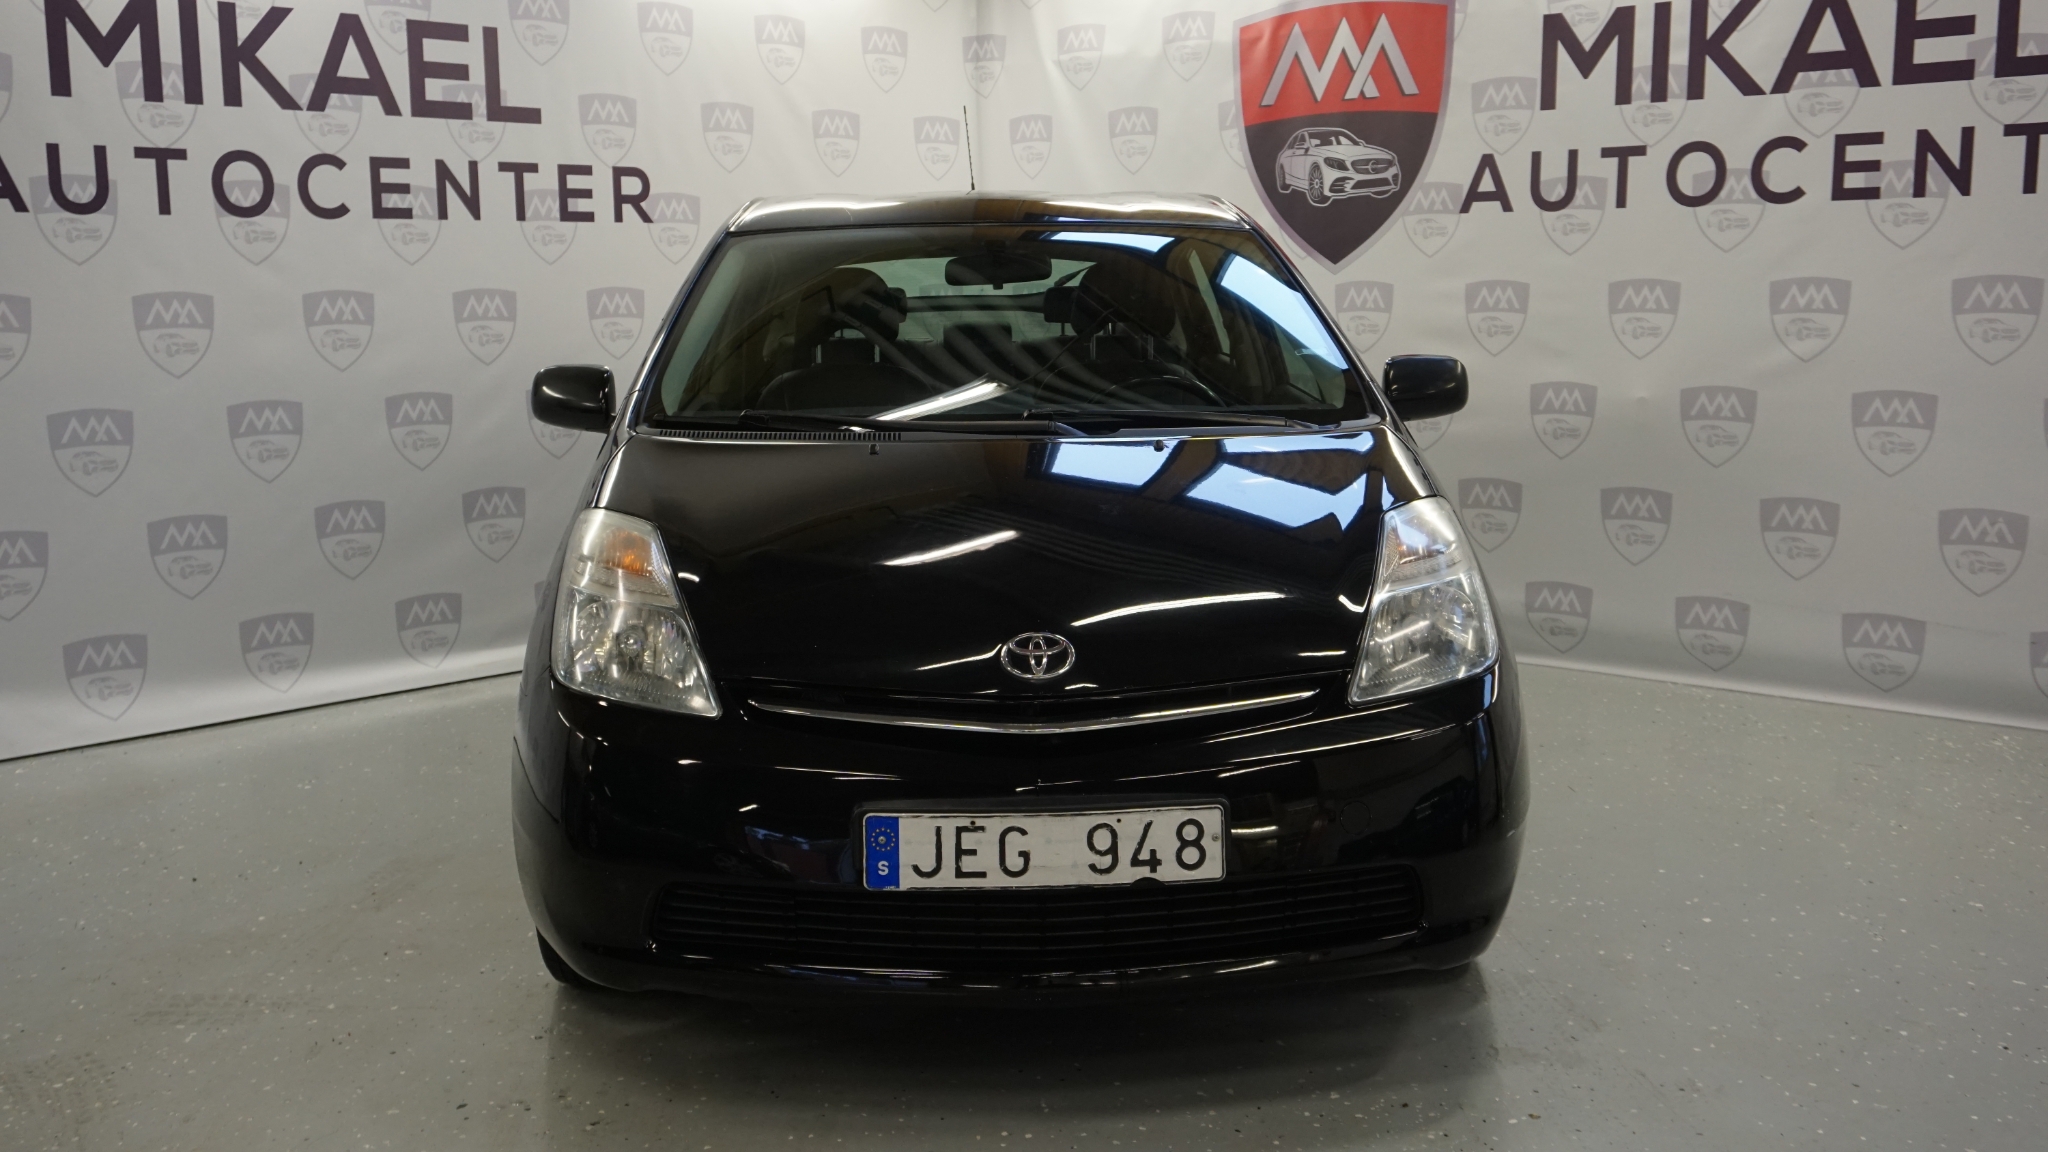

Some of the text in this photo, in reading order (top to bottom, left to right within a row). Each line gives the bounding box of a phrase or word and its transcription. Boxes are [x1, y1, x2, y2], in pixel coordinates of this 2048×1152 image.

[44, 0, 542, 124] MIKAEL
[1459, 122, 2048, 214] AUTOCENT
[877, 860, 889, 876] S
[911, 818, 1207, 879] JEG 948
